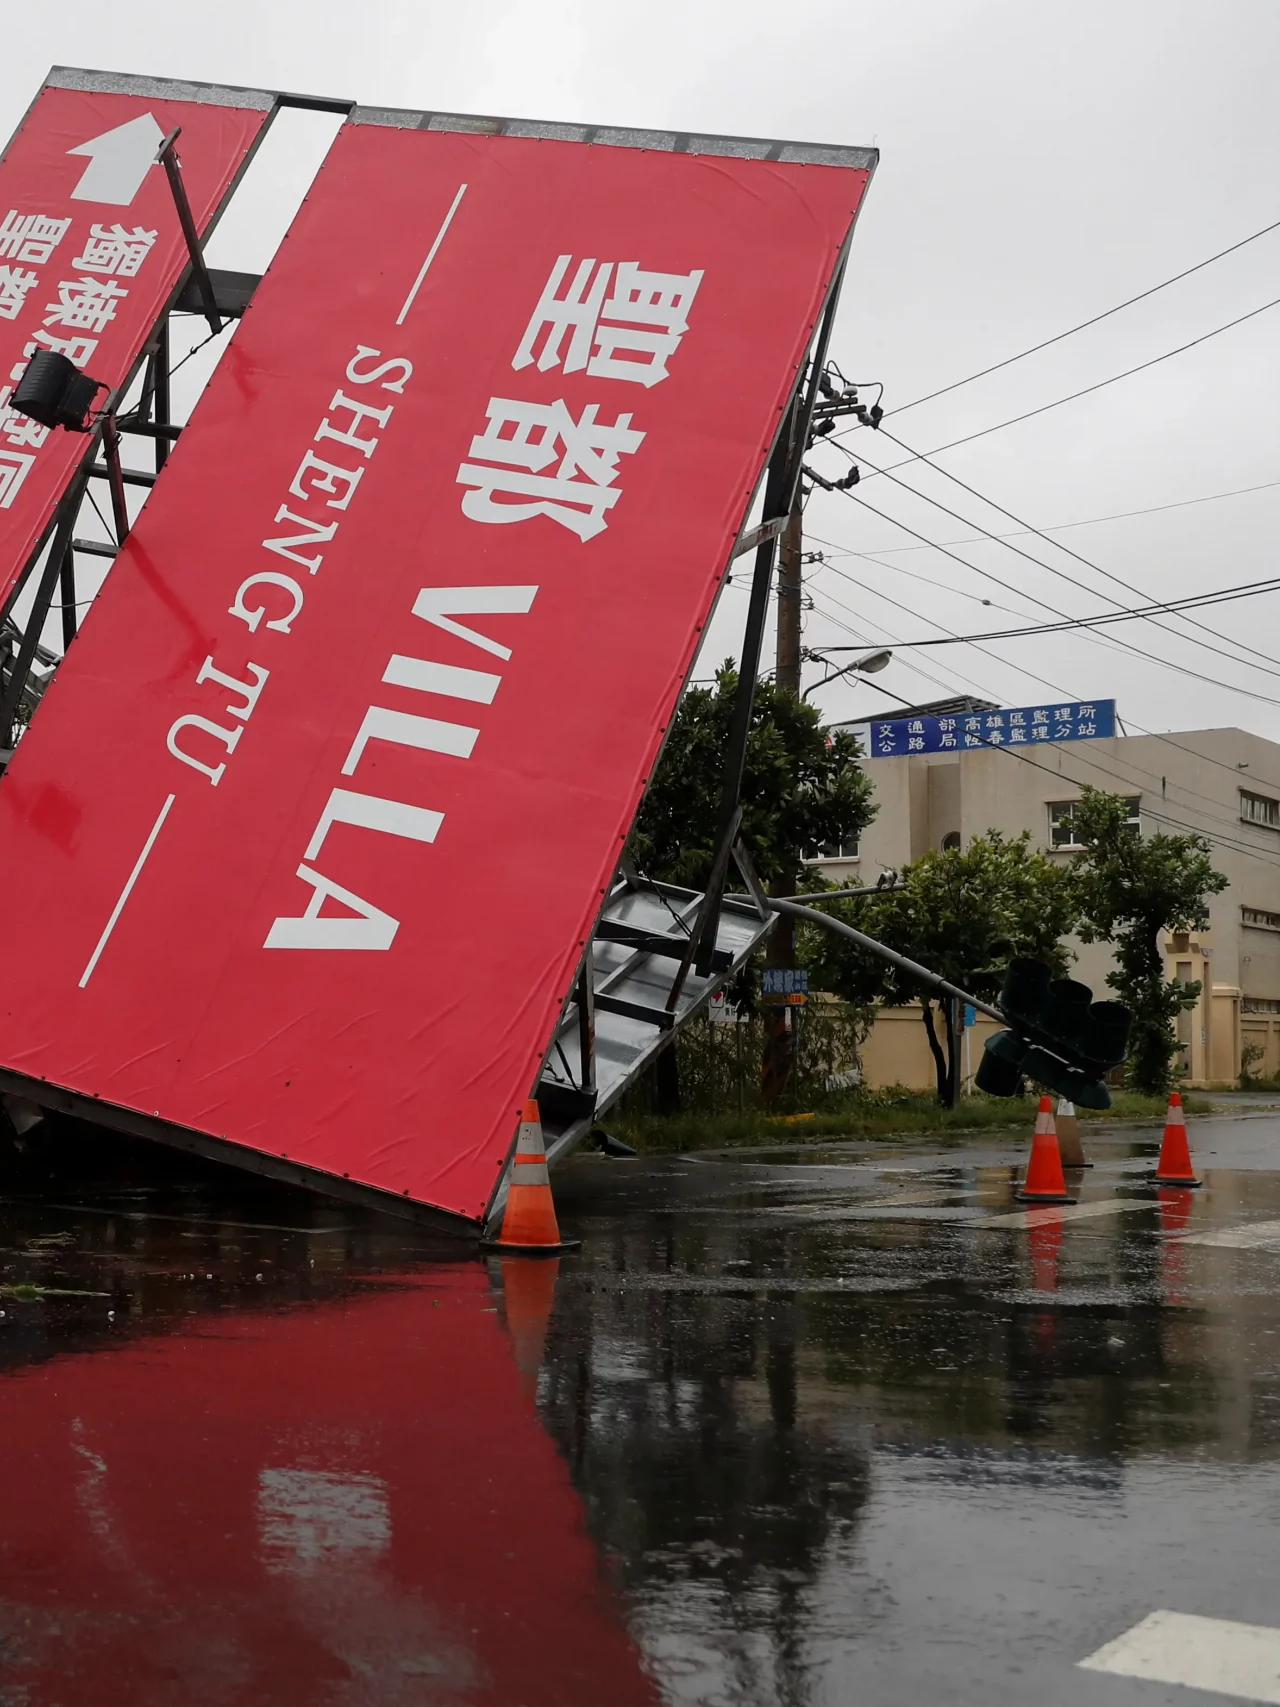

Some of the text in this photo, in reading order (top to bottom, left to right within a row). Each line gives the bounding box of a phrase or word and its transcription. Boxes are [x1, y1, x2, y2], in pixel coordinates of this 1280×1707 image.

[167, 345, 414, 787] SHENG TU
[264, 256, 706, 952] 聖都 VILLA
